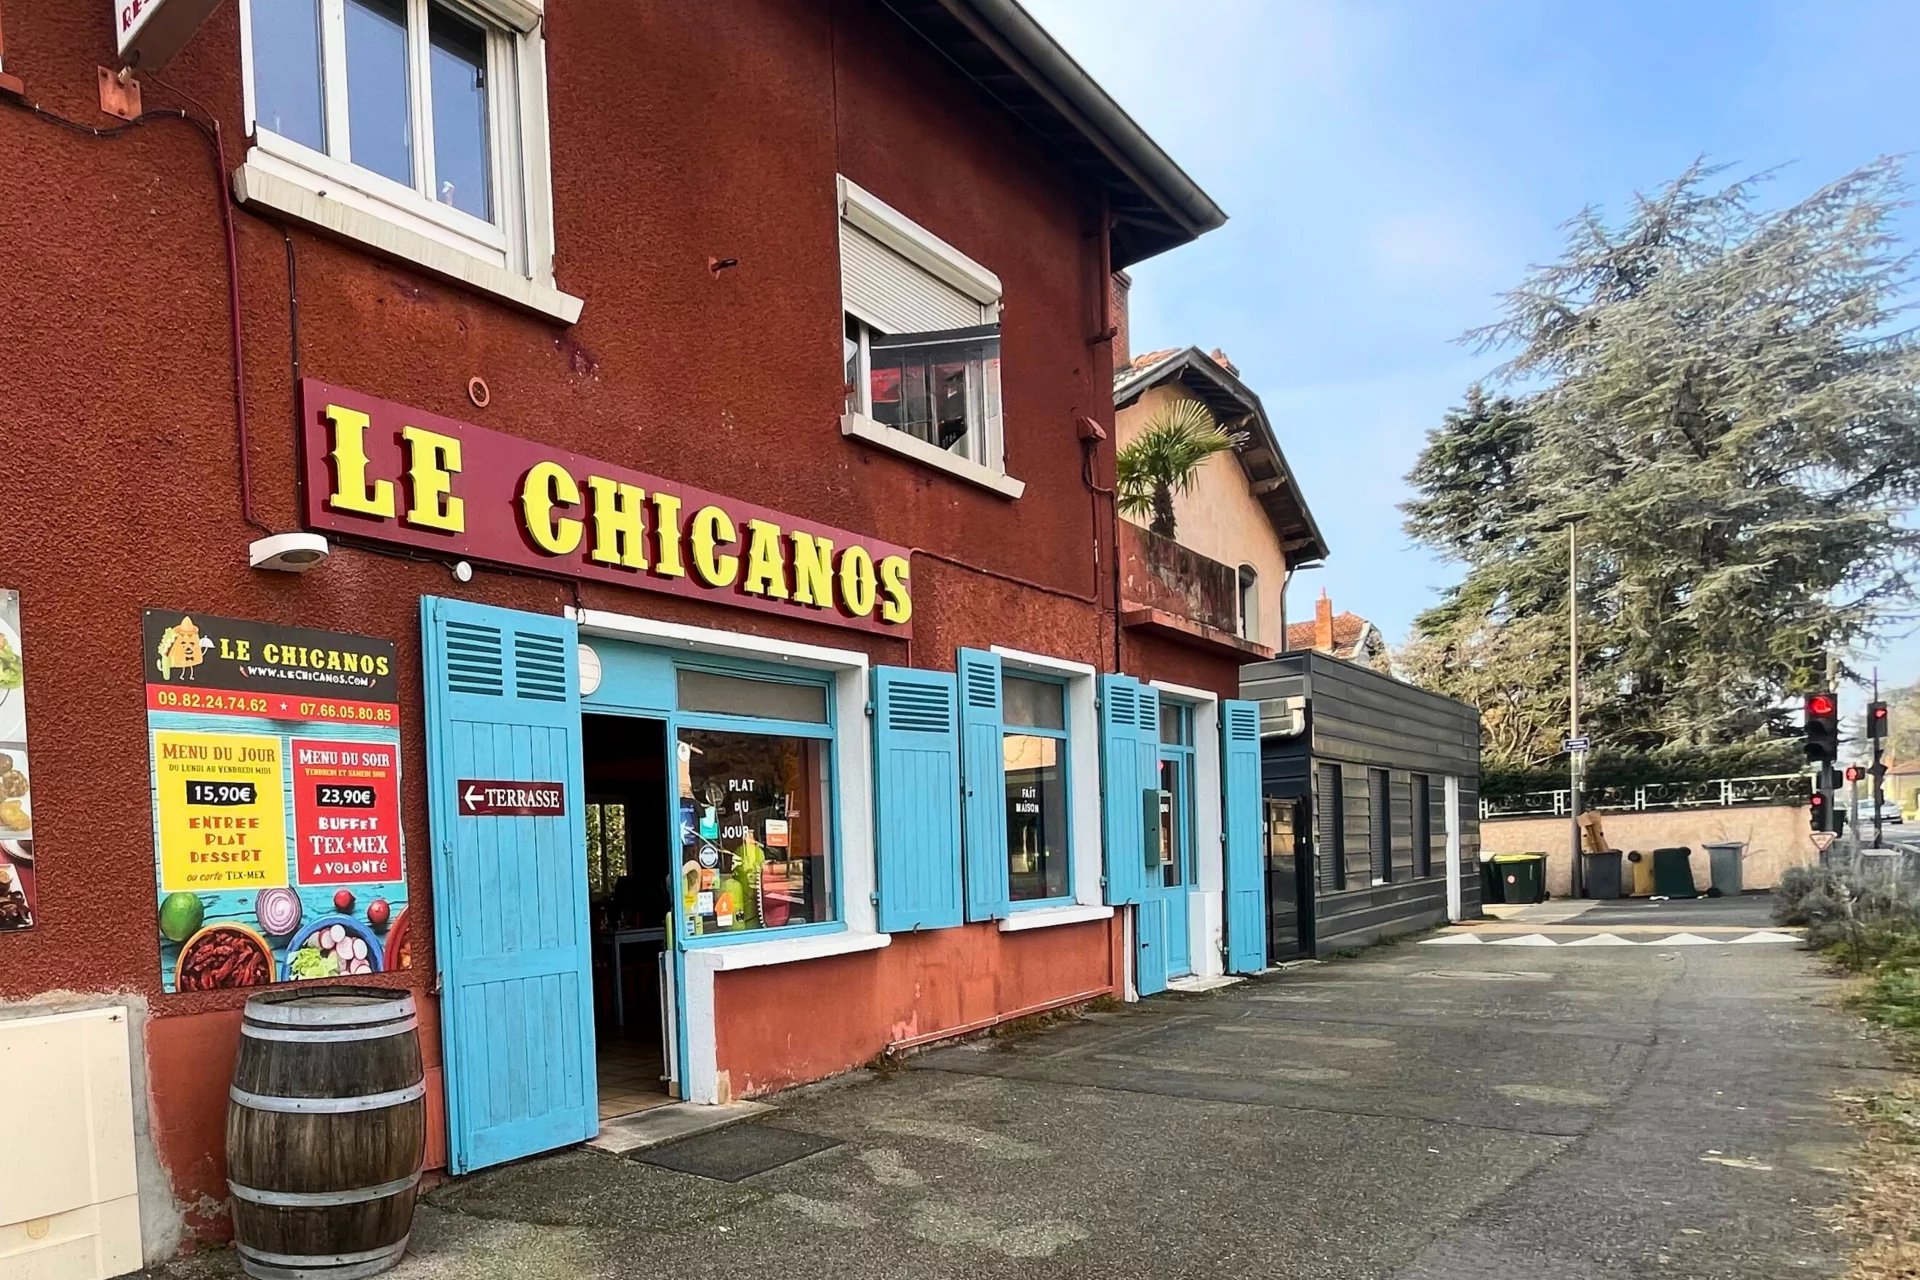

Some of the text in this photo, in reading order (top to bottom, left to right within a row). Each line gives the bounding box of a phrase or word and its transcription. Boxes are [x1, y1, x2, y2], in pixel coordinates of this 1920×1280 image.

[122, 0, 150, 32] RE
[326, 404, 913, 624] LE CHICANOS
[220, 638, 389, 676] LE CHICANOS
[247, 666, 368, 686] WWW.LECHICANOS.COM
[158, 691, 391, 721] 09.82.24.74.62 07.66.05.80.85
[162, 743, 275, 763] MENU DU JOUR
[299, 749, 390, 767] MENU DU SOIR
[169, 764, 271, 775] DU LUNDI AU VENDREDI MIDI
[729, 779, 754, 791] PLAT
[195, 786, 251, 803] 15,90€
[321, 788, 371, 805] 23,90€
[485, 788, 560, 808] TERRASSE
[189, 816, 259, 829] ENTREE
[205, 833, 246, 846] PLAT
[722, 826, 749, 838] JOUR
[190, 849, 261, 863] DESSERT
[187, 870, 265, 882] ou carte TEX-MEX
[313, 863, 322, 875] A
